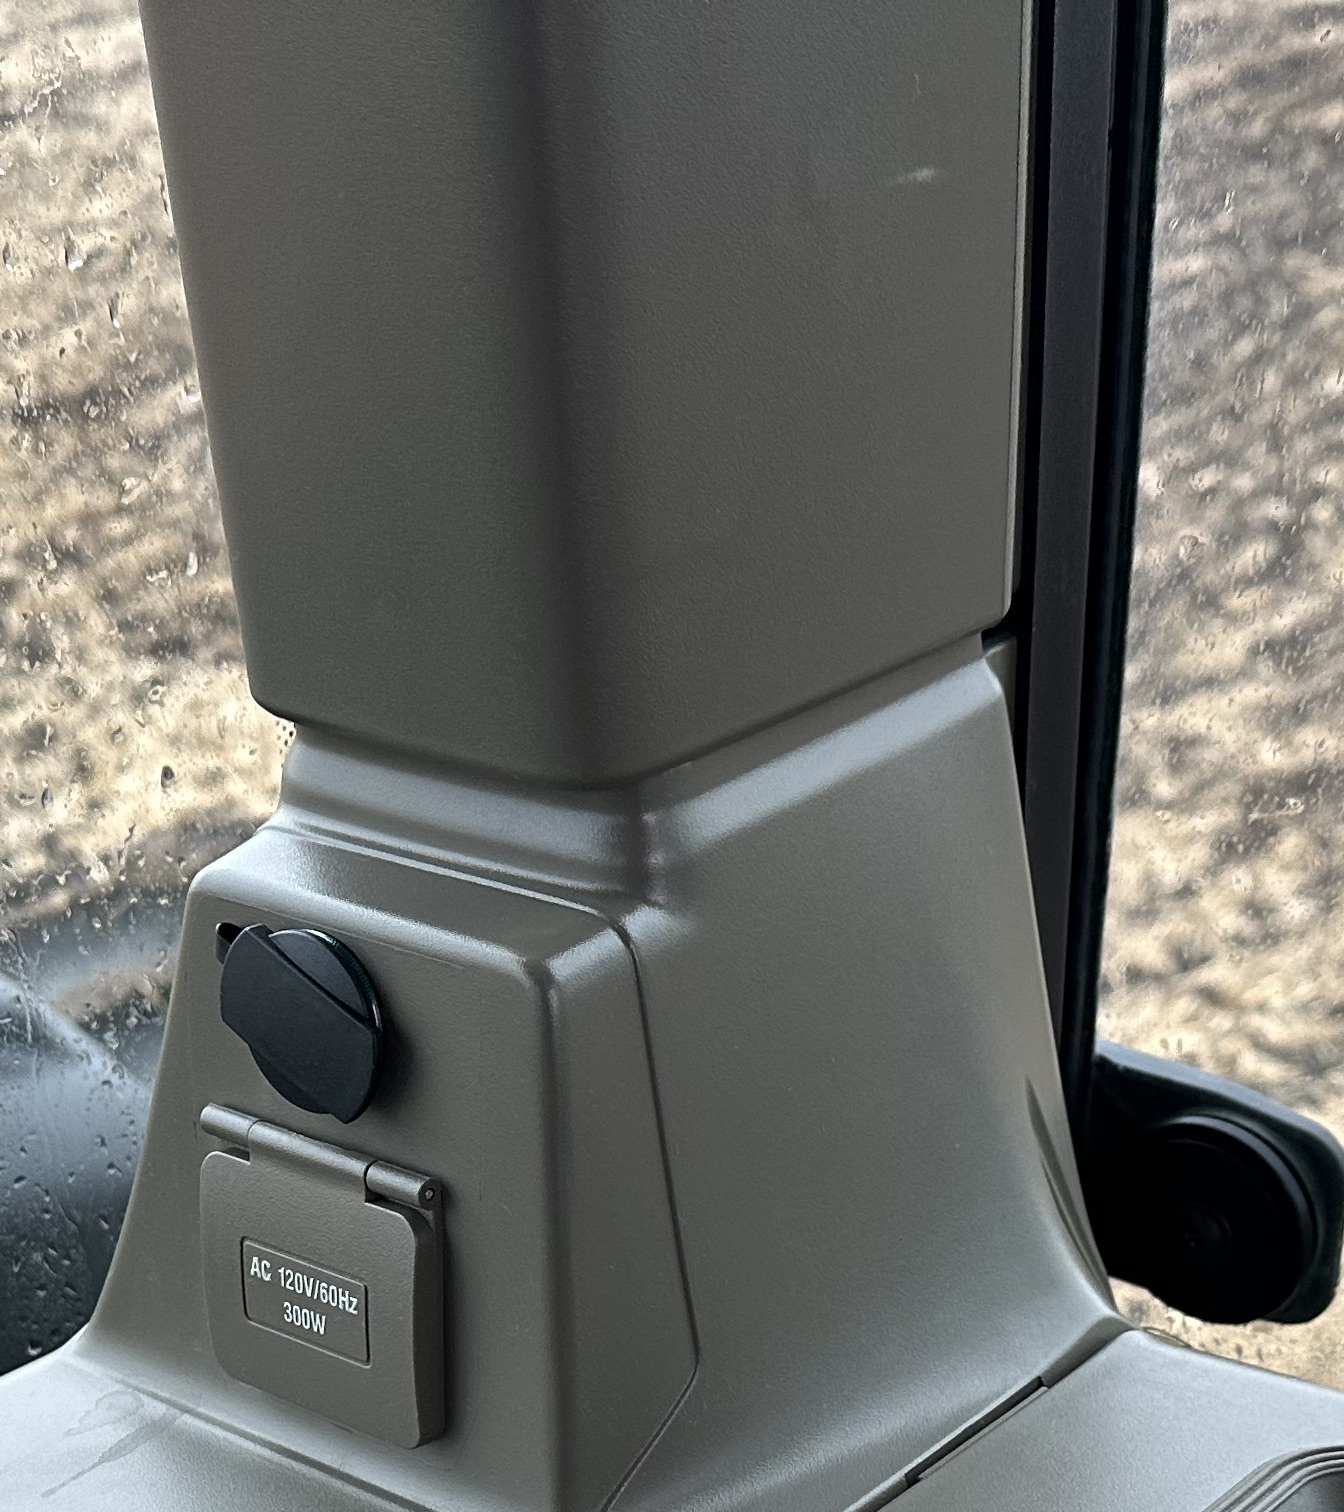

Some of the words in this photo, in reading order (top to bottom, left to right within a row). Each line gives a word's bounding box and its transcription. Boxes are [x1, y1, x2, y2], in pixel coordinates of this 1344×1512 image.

[250, 1256, 272, 1281] AC
[277, 1266, 358, 1315] 120V/60Hz
[283, 1301, 326, 1335] 300W
